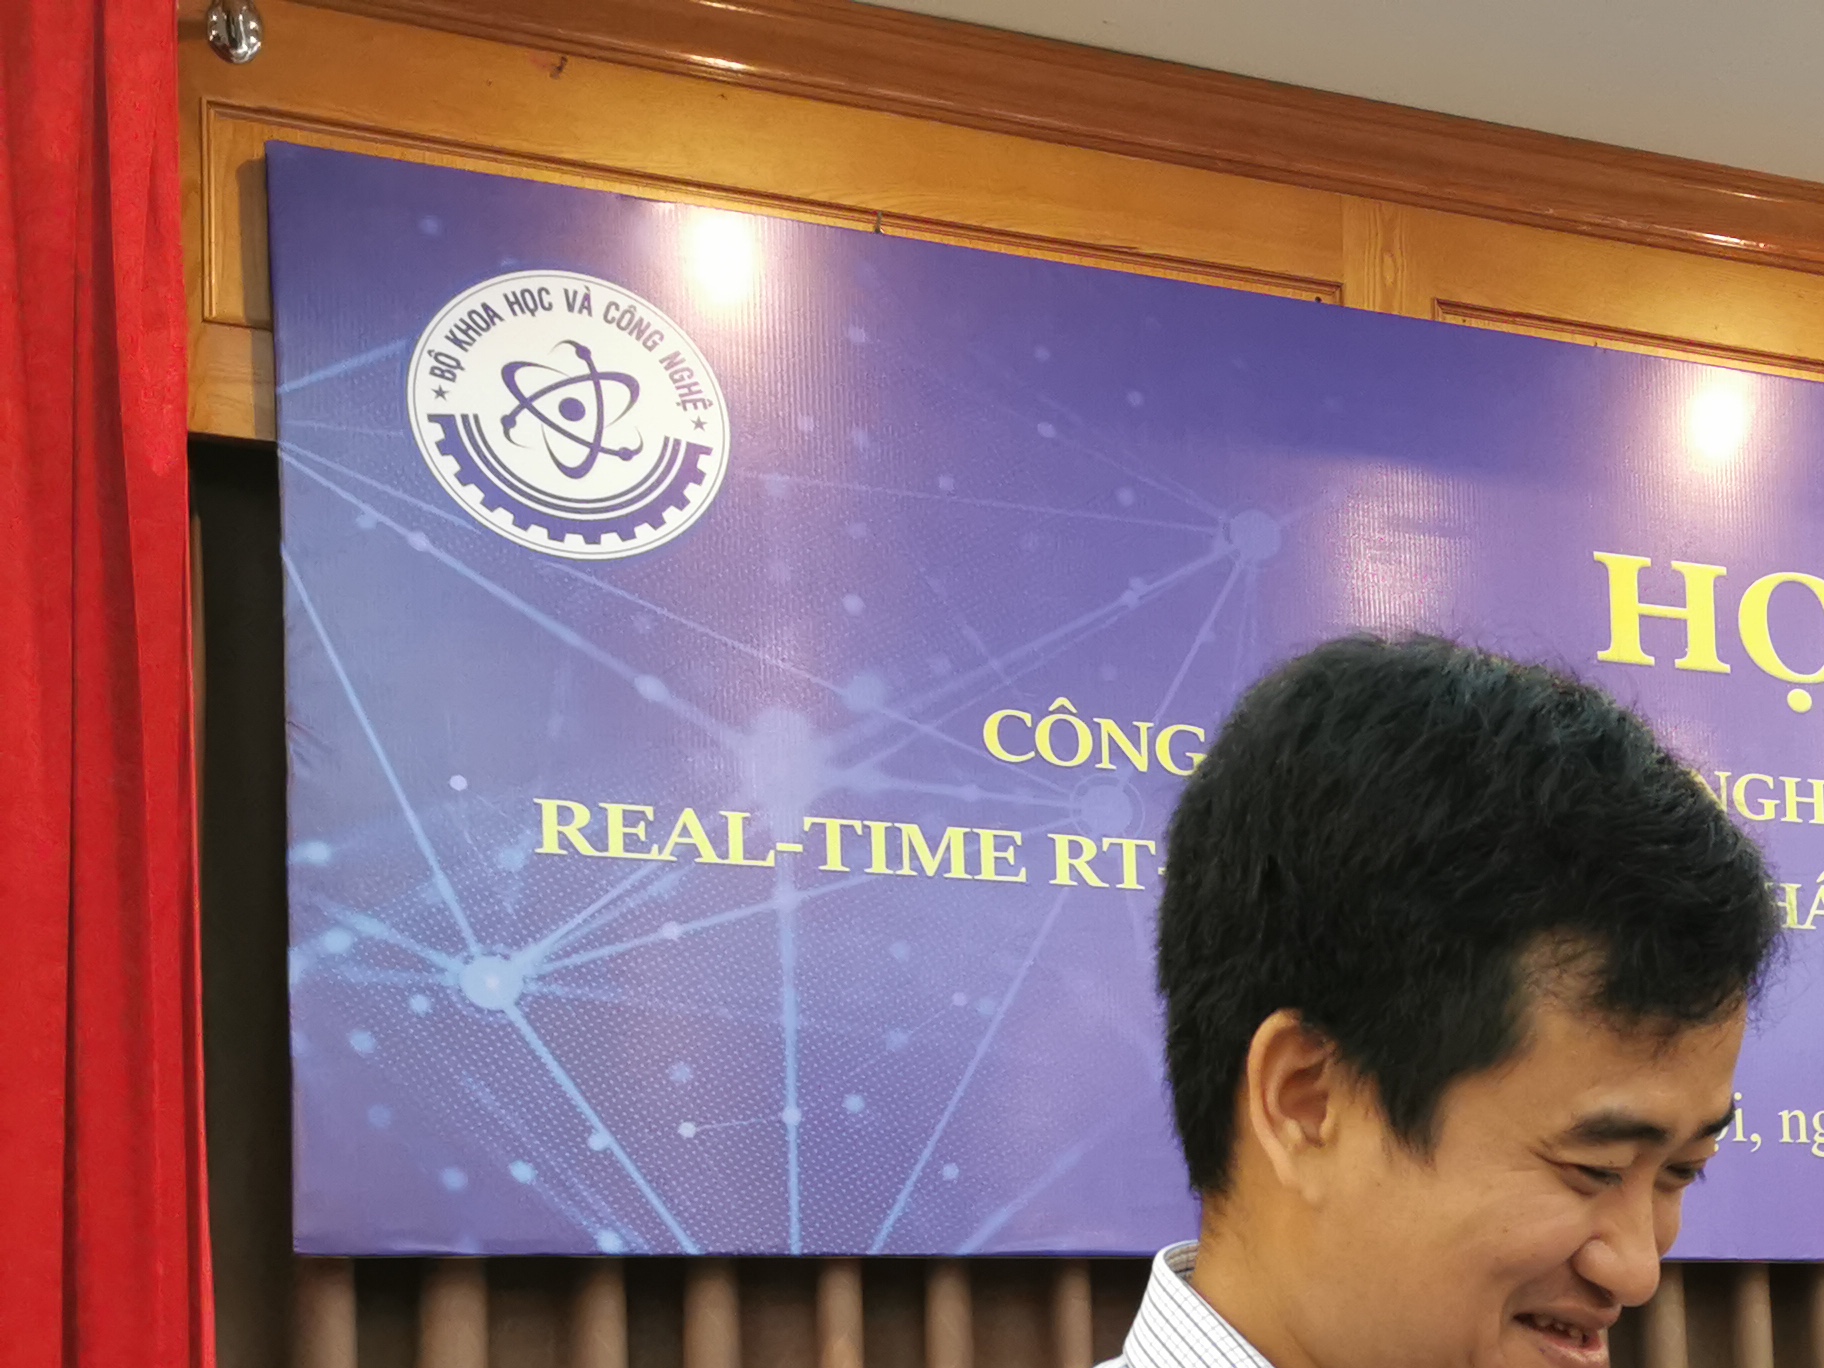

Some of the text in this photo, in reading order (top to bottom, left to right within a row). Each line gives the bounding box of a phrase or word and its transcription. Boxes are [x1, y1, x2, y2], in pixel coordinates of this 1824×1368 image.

[427, 285, 713, 411] BỘ KHOA HỌC VÀ CÔNG NGHỆ
[983, 697, 1205, 775] CÔNG
[534, 798, 1027, 884] REAL-TIME
[1047, 834, 1165, 890] RT
